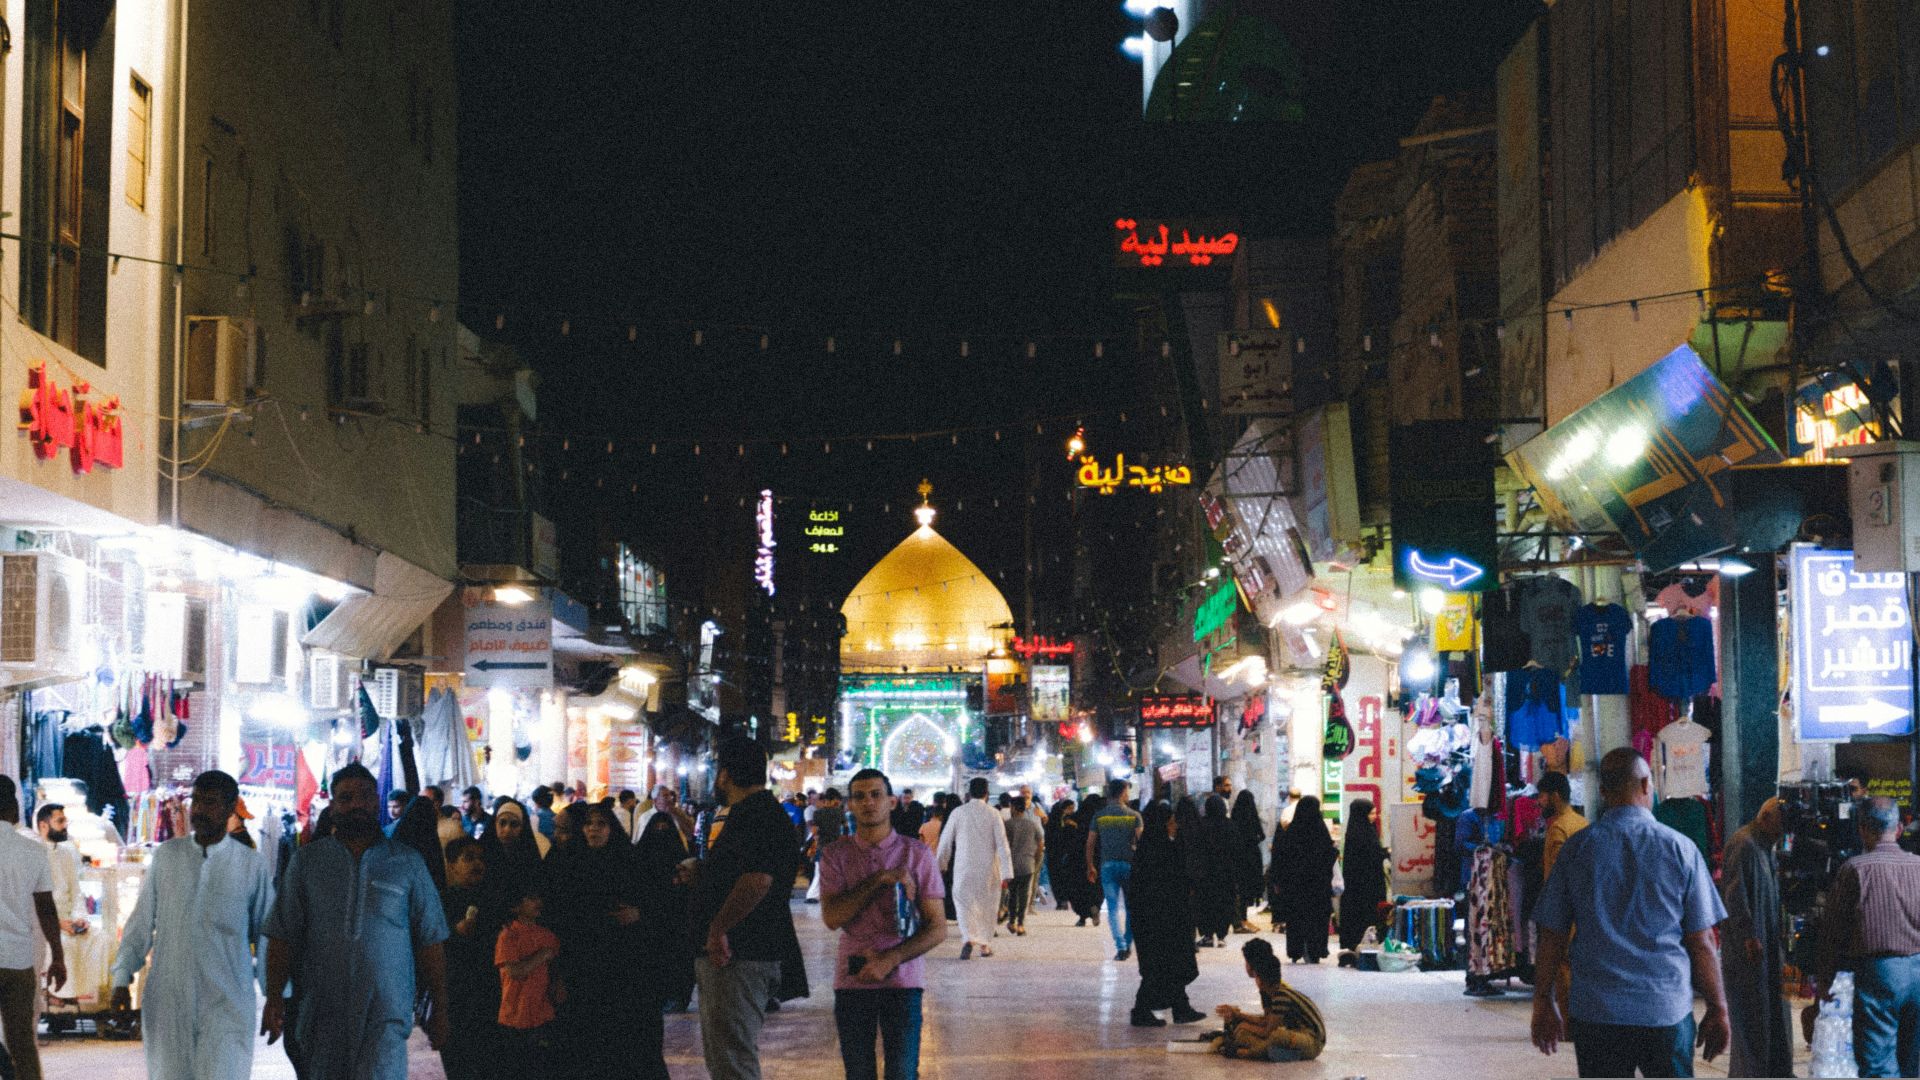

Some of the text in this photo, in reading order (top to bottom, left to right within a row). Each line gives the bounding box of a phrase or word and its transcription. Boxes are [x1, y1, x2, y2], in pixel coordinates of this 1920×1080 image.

[1115, 218, 1238, 265] صيدلية
[1079, 453, 1190, 493] صيدلية
[1818, 563, 1905, 597] فندق
[469, 619, 547, 631] فندق ومطعم
[1822, 597, 1905, 636] قصر
[1820, 636, 1909, 679] البشير
[1345, 696, 1395, 838] صيدل
